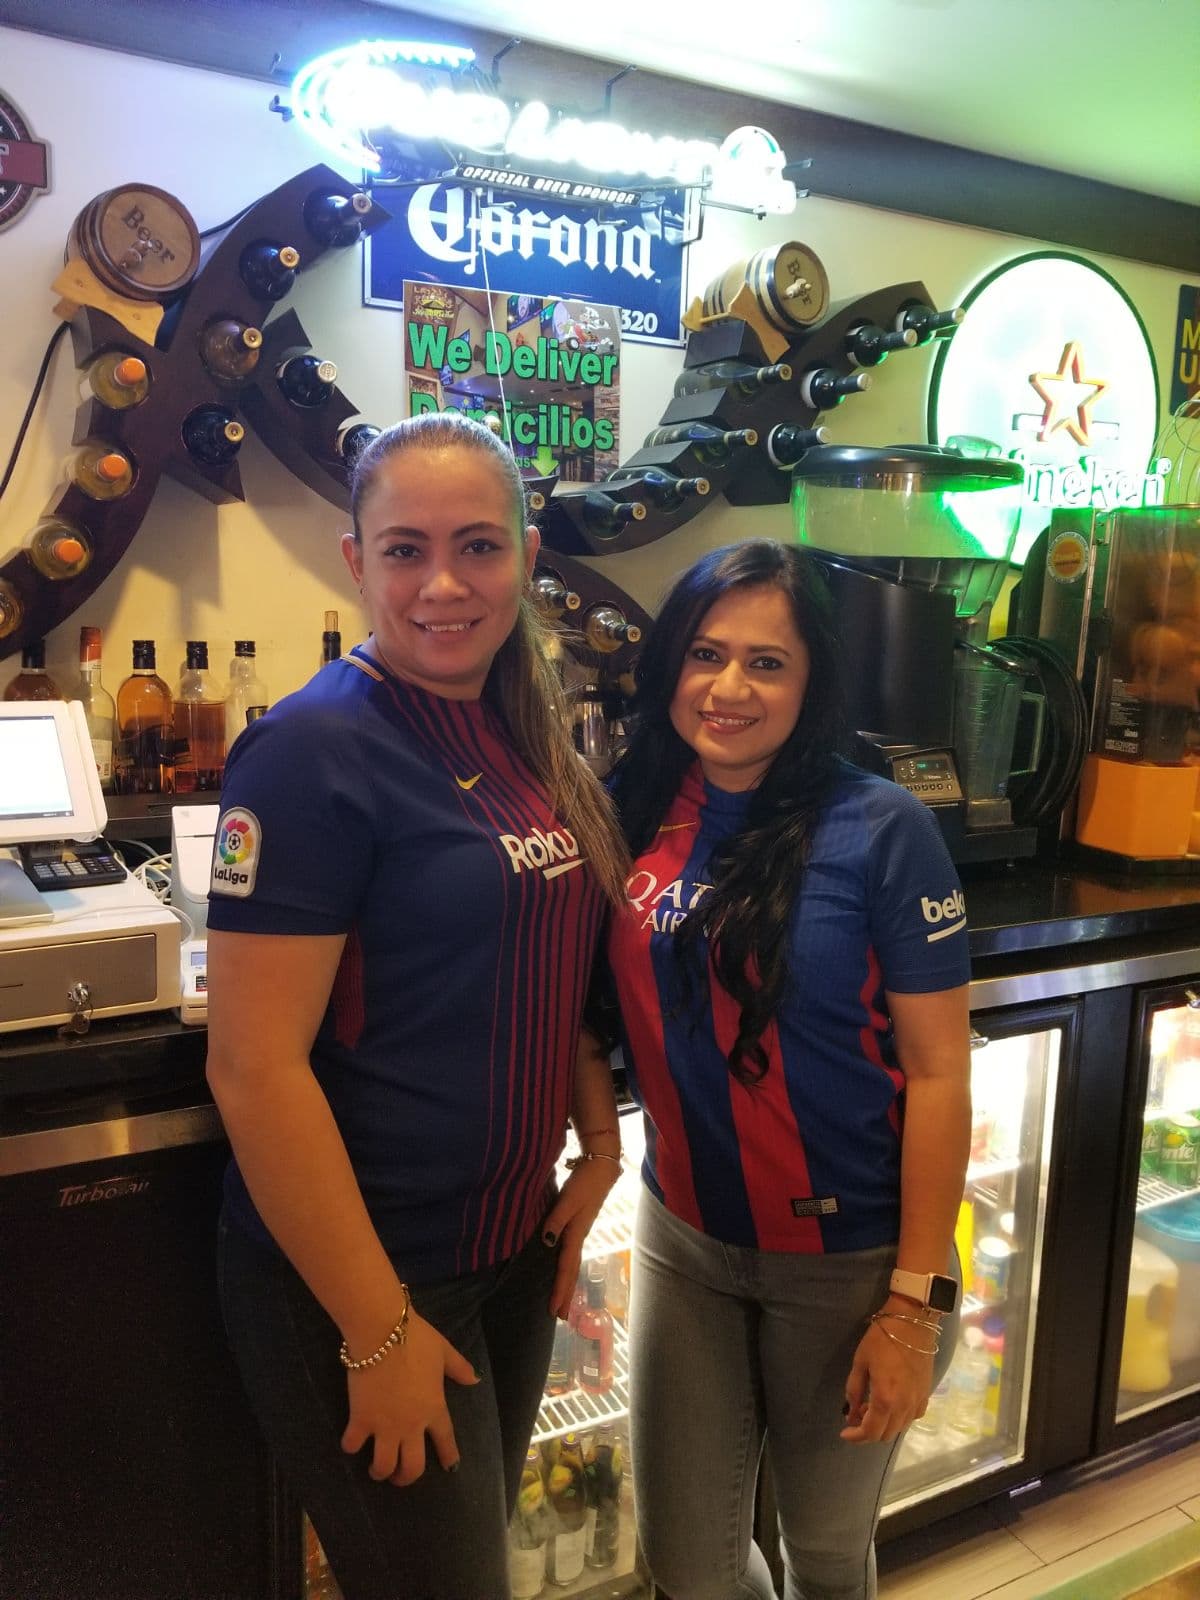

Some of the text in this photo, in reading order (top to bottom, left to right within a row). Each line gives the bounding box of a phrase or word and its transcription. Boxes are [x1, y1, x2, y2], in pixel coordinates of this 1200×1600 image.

[463, 166, 636, 204] OFFICIAL BEER SPONSOR
[122, 205, 176, 264] Beer
[407, 182, 655, 280] Corona
[621, 309, 658, 334] 320
[408, 322, 617, 386] We Deliver
[1180, 351, 1200, 384] U
[411, 392, 615, 450] Dicilios
[214, 867, 248, 885] LaLiga
